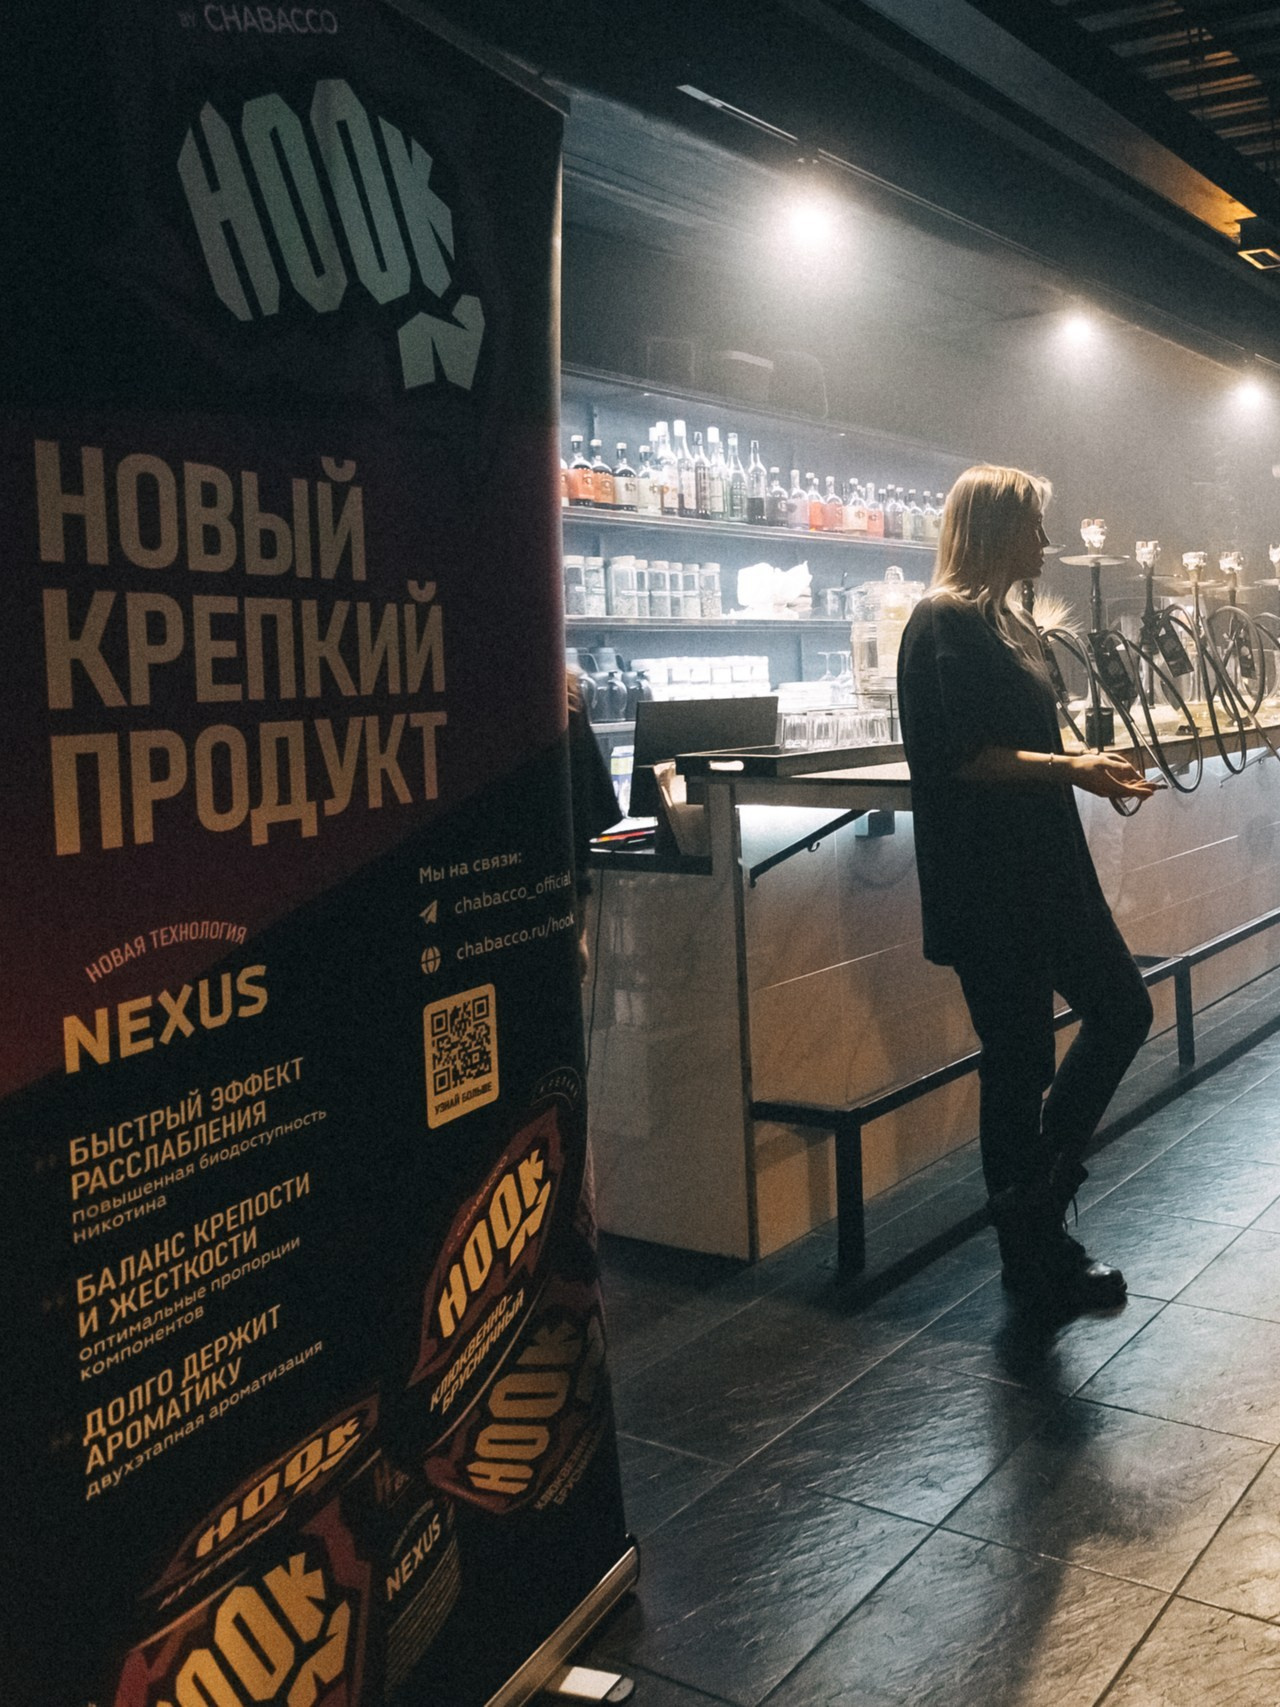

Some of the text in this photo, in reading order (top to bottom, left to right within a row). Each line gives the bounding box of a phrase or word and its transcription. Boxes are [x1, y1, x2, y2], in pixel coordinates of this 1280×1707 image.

[204, 4, 338, 34] CHABACCO
[34, 440, 366, 581] НОВЫЙ
[42, 580, 445, 710] КРЕПКИЙ
[50, 711, 447, 856] ПРОДУКТ
[418, 852, 523, 885] Мы на связи:
[454, 869, 572, 915] chabacco_official
[85, 920, 248, 984] НОВАЯ ТЕХНОЛОГИЯ
[456, 910, 575, 961] chabacco.ru/hook
[63, 964, 269, 1075] NEXUS
[69, 1056, 304, 1168] БЫСТРЫЙ ЭФФЕКТ
[70, 1100, 268, 1201] РАССЛАБЛЕНИЯ
[434, 1081, 493, 1116] УЗНАЙ БОЛЬШЕ
[71, 1108, 327, 1224] повышенная биодоступность
[72, 1194, 168, 1244] никотина
[76, 1171, 311, 1305] БАЛАНС КРЕПОСТИ
[78, 1226, 258, 1339] И ЖЕСТКОСТИ
[437, 1148, 544, 1339] HOOK
[78, 1236, 301, 1362] оптимальные пропорции
[80, 1305, 205, 1382] компонентов
[83, 1304, 282, 1447] ДОЛГО ДЕРЖИТ
[84, 1355, 243, 1476] АРОМАТИКУ
[85, 1339, 323, 1502] двухэтапная ароматизация
[465, 1319, 584, 1496] HOOK
[195, 1416, 360, 1559] HOOK
[385, 1512, 443, 1601] NEXUS
